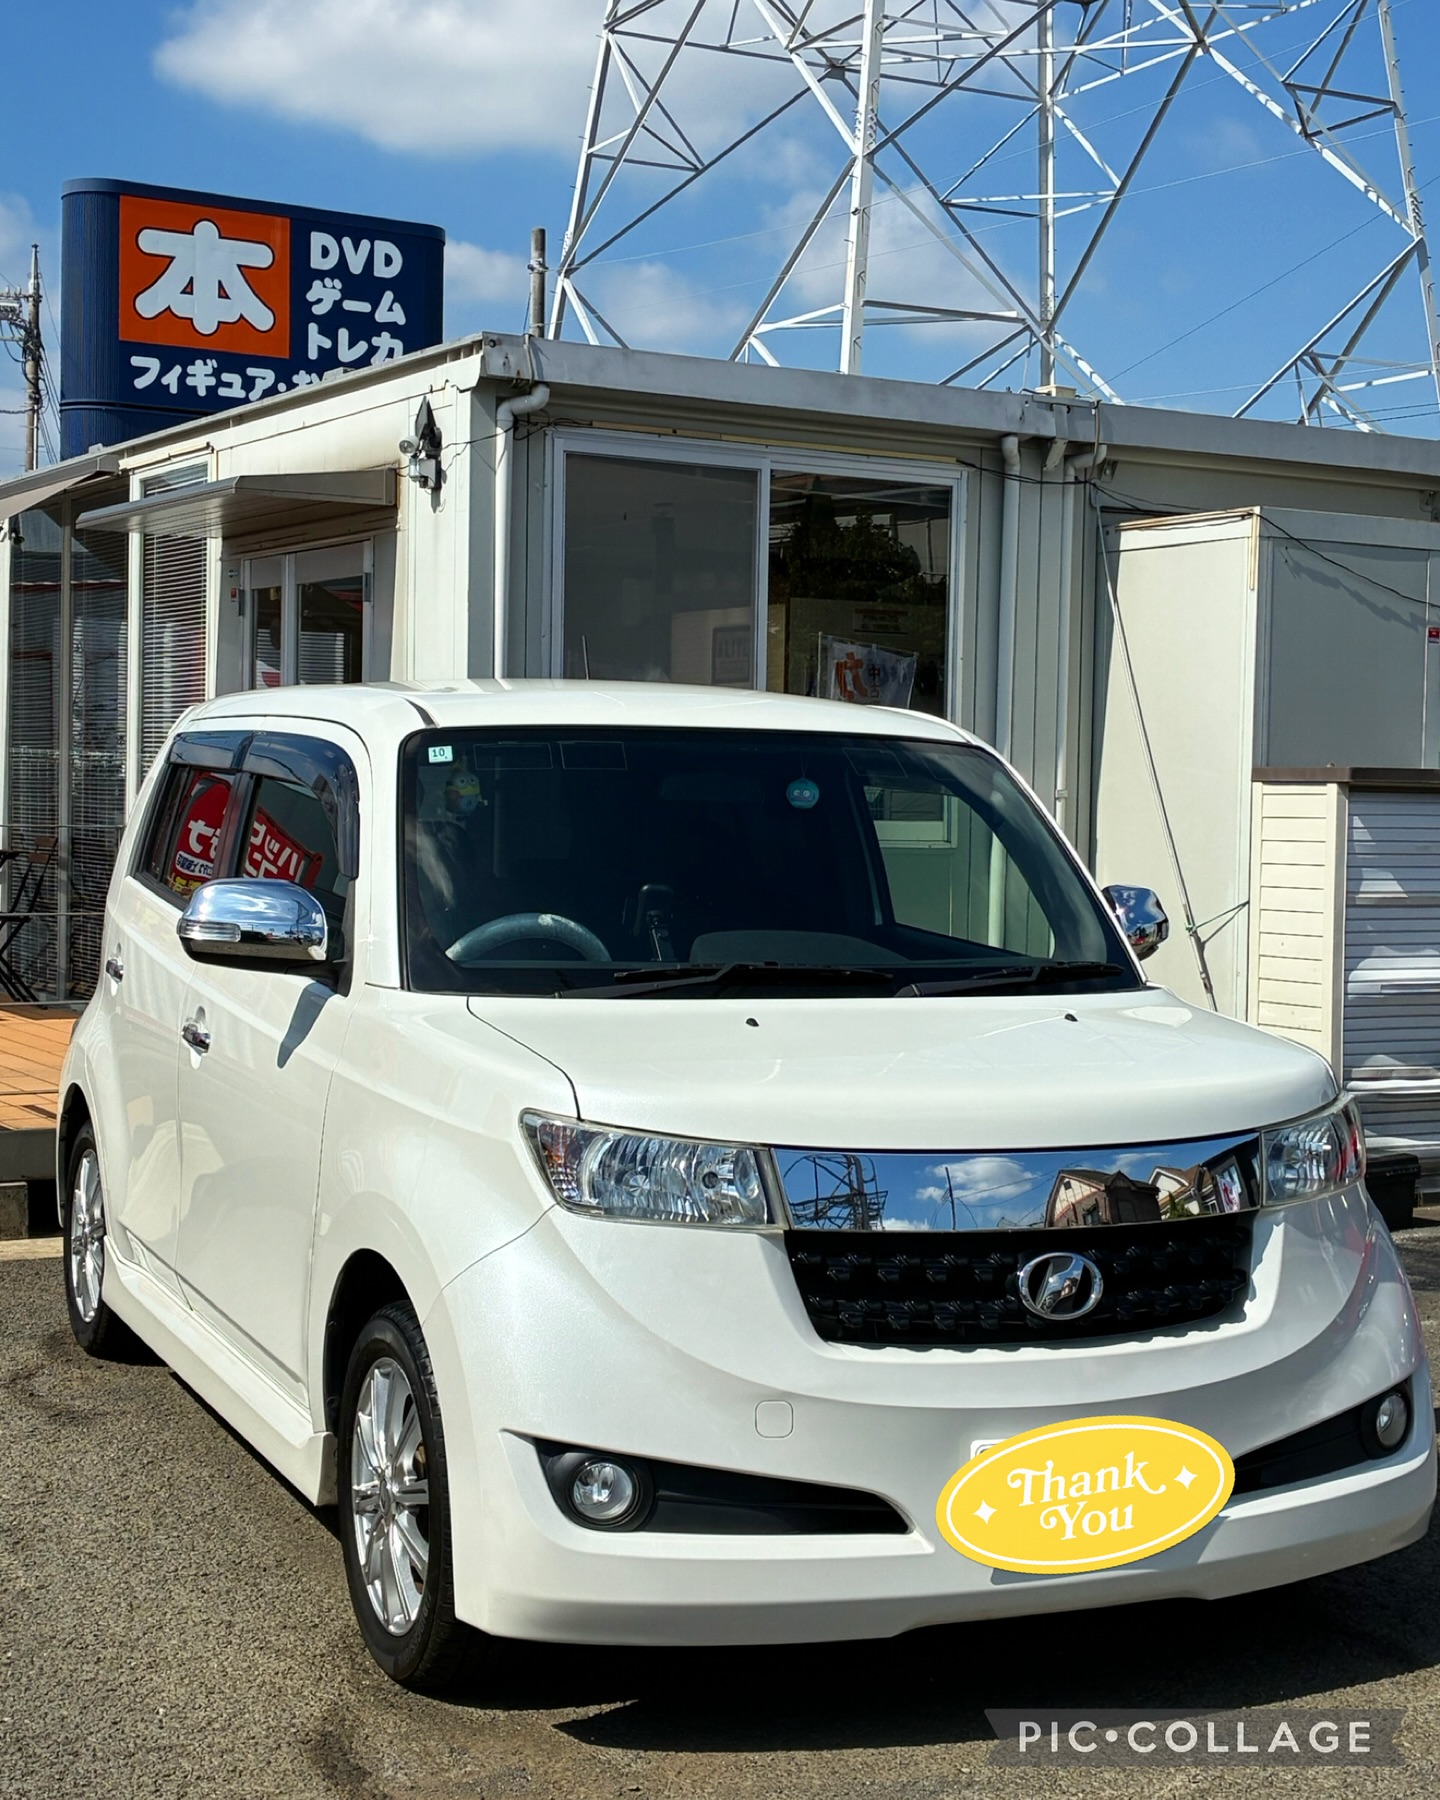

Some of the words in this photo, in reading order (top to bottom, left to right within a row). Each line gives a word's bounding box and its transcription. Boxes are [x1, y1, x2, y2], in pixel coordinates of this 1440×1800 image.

[134, 219, 275, 335] 本
[310, 231, 403, 278] DVD
[306, 277, 406, 326] ゲーム
[307, 322, 404, 364] トレカ
[432, 748, 445, 757] 10
